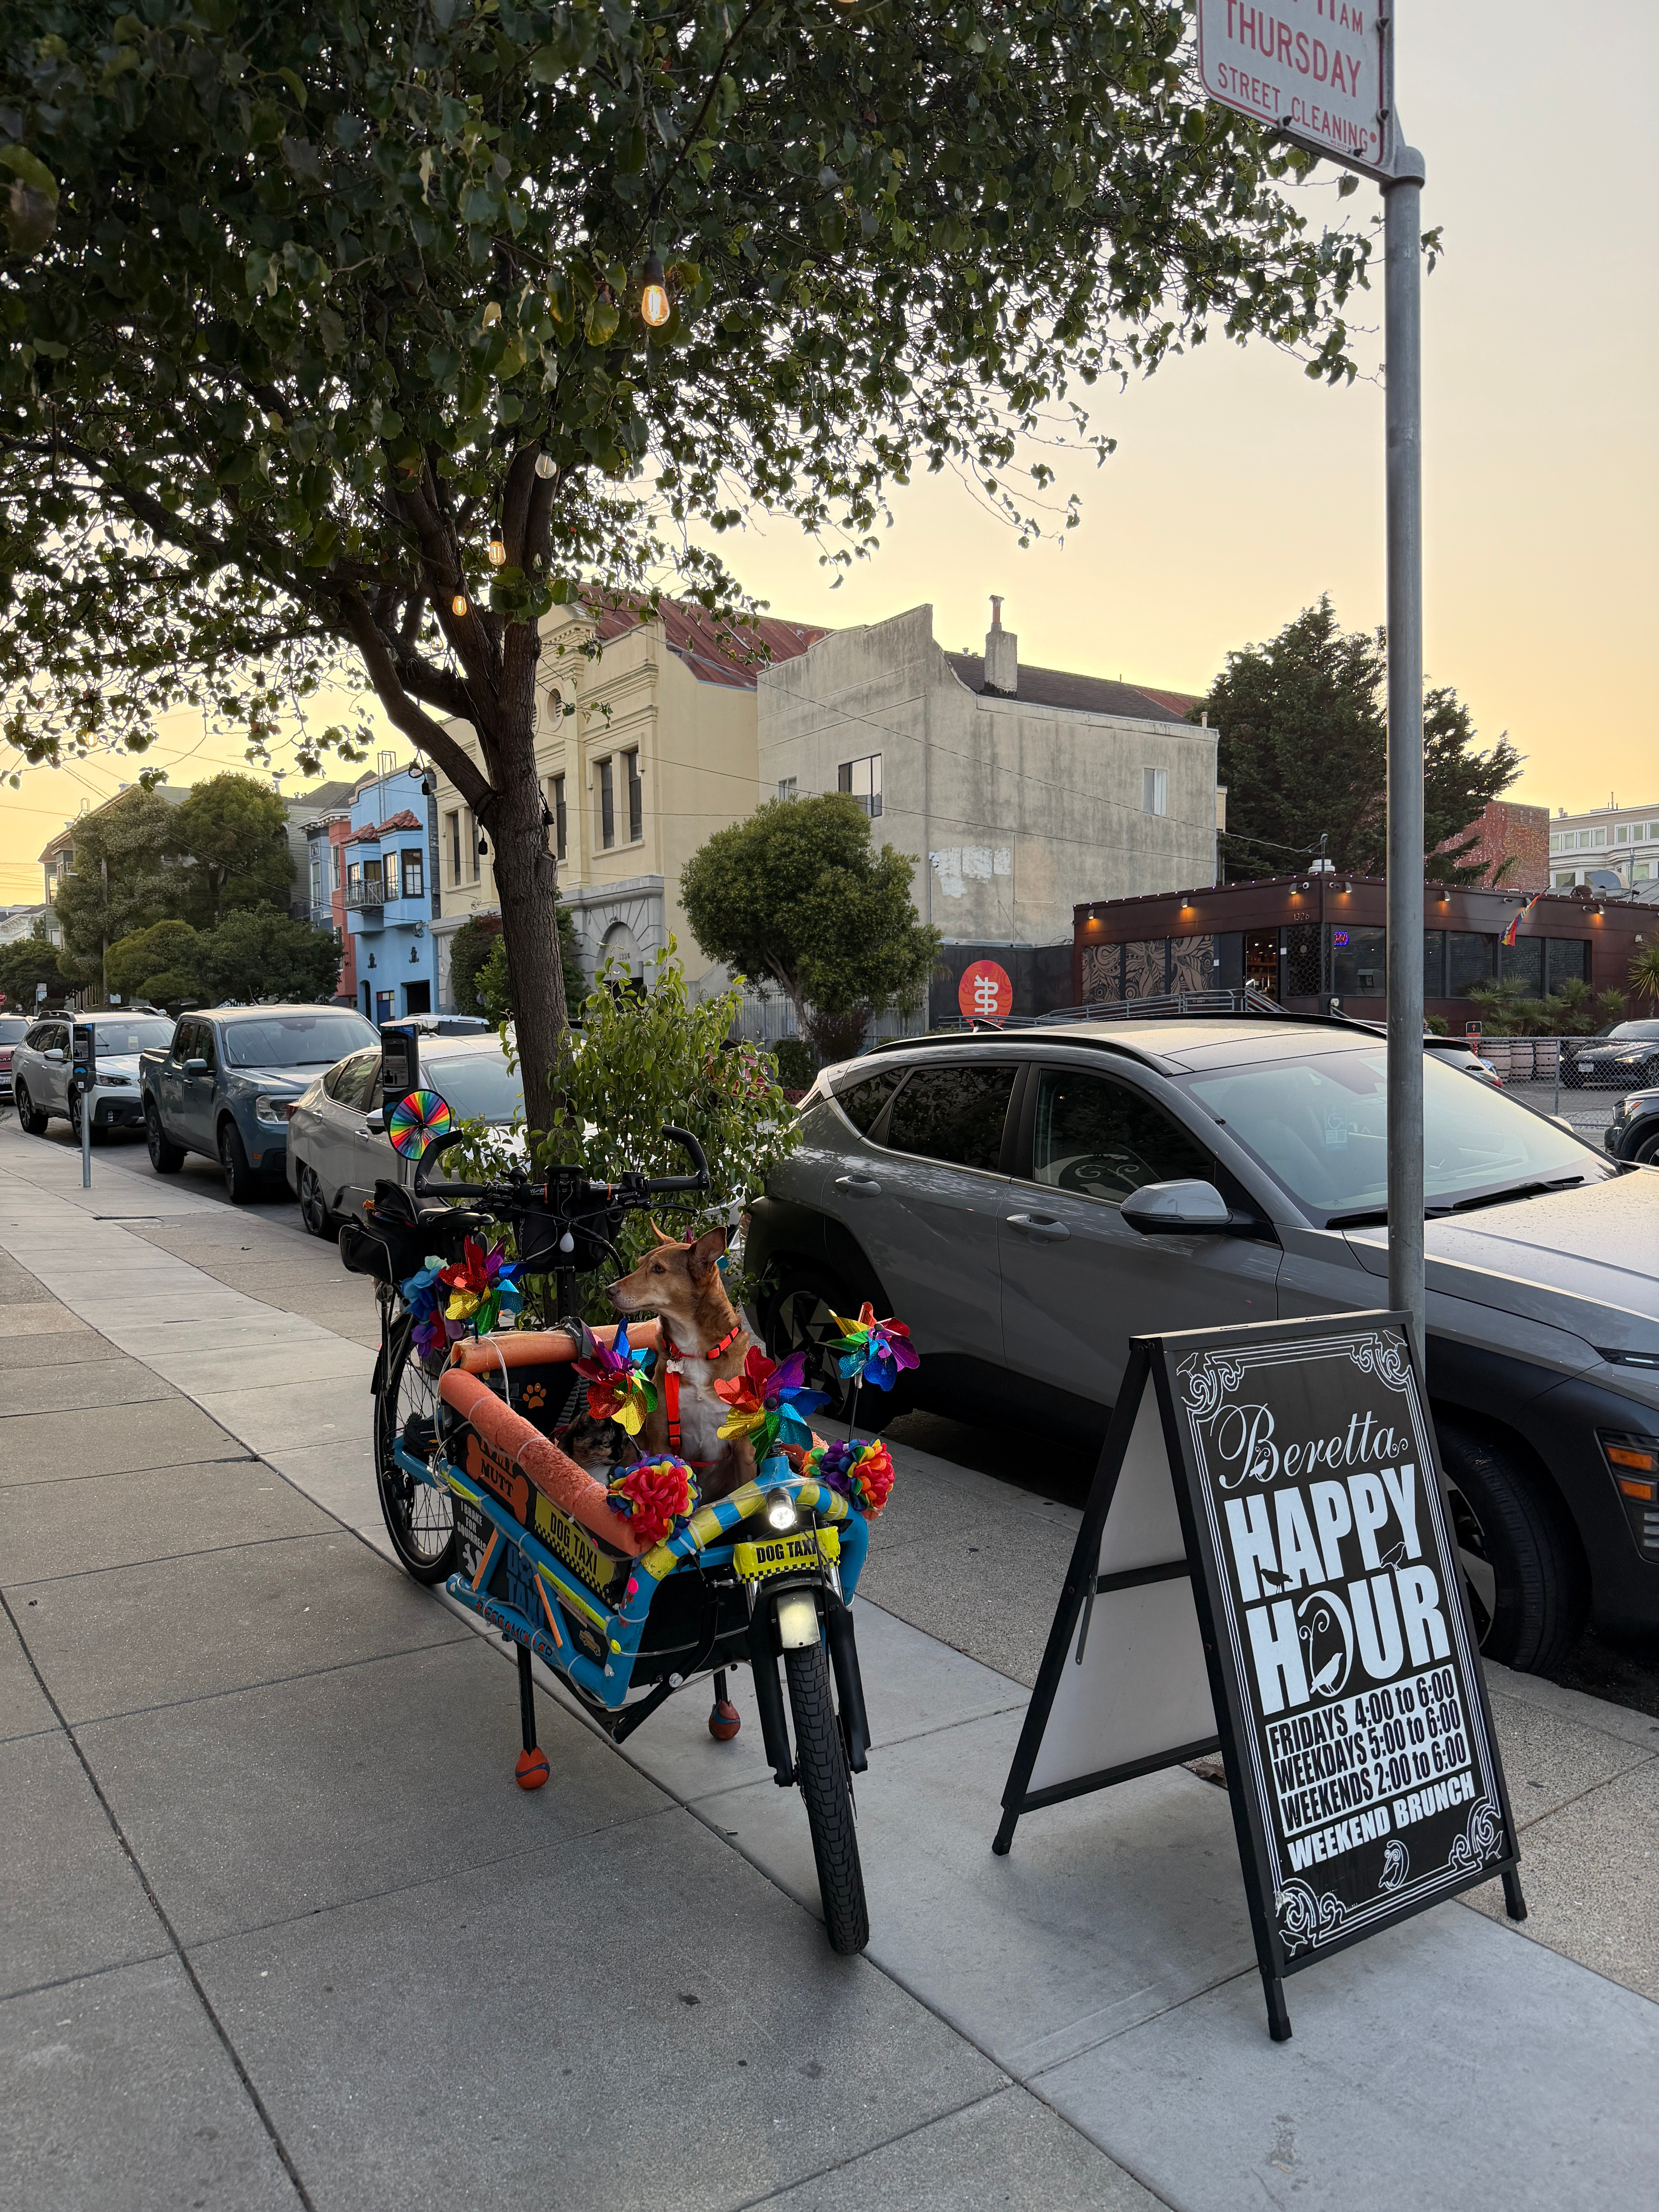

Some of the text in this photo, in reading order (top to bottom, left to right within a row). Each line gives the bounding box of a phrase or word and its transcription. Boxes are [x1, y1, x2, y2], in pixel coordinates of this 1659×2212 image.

[1226, 0, 1361, 98] THURSDAY
[1218, 62, 1368, 153] STREET CLEANING
[481, 1458, 514, 1498] MUTT
[1211, 1403, 1408, 1489] Beretta
[457, 1521, 487, 1553] SQUIRRELS
[461, 1501, 483, 1527] I BRAKE
[466, 1516, 476, 1534] FOR
[550, 1511, 597, 1575] DOG TAXI
[756, 1537, 816, 1564] DOG TAXI
[1224, 1463, 1422, 1602] HAPPY
[1245, 1565, 1450, 1715] HOUR
[1269, 1669, 1454, 1760] FRIDAYS 4:00 to 6:00
[1274, 1699, 1461, 1794] WEEKDAYS 5:00 to 6:00
[1281, 1733, 1466, 1831] WEEKENDS 2:00 to 6:00
[1287, 1771, 1475, 1872] WEEKEND BRUNCH
